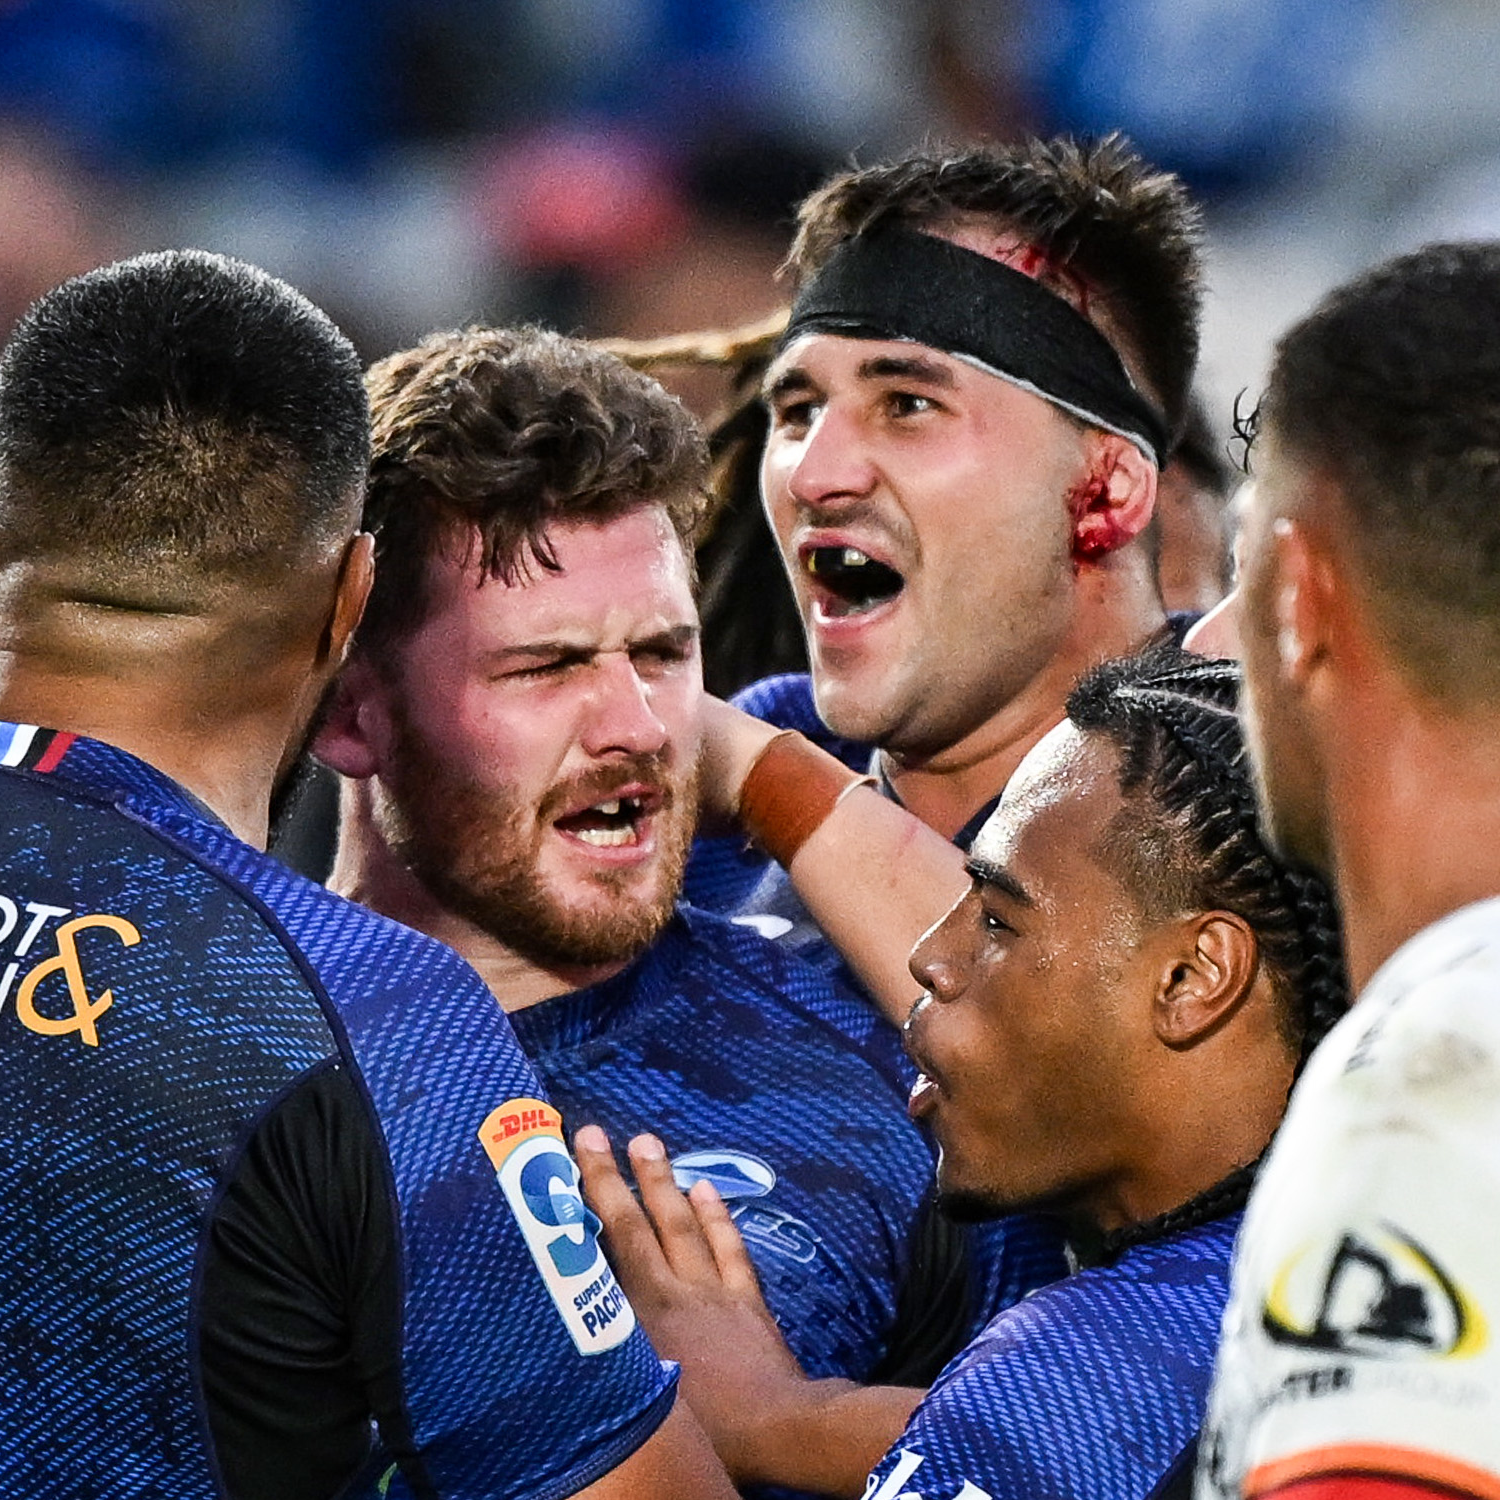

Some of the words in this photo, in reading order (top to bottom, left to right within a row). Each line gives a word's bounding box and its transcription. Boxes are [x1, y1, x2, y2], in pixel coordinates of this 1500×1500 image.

[15, 914, 141, 1047] &
[492, 1109, 558, 1143] DHL
[582, 1283, 626, 1338] PACIF
